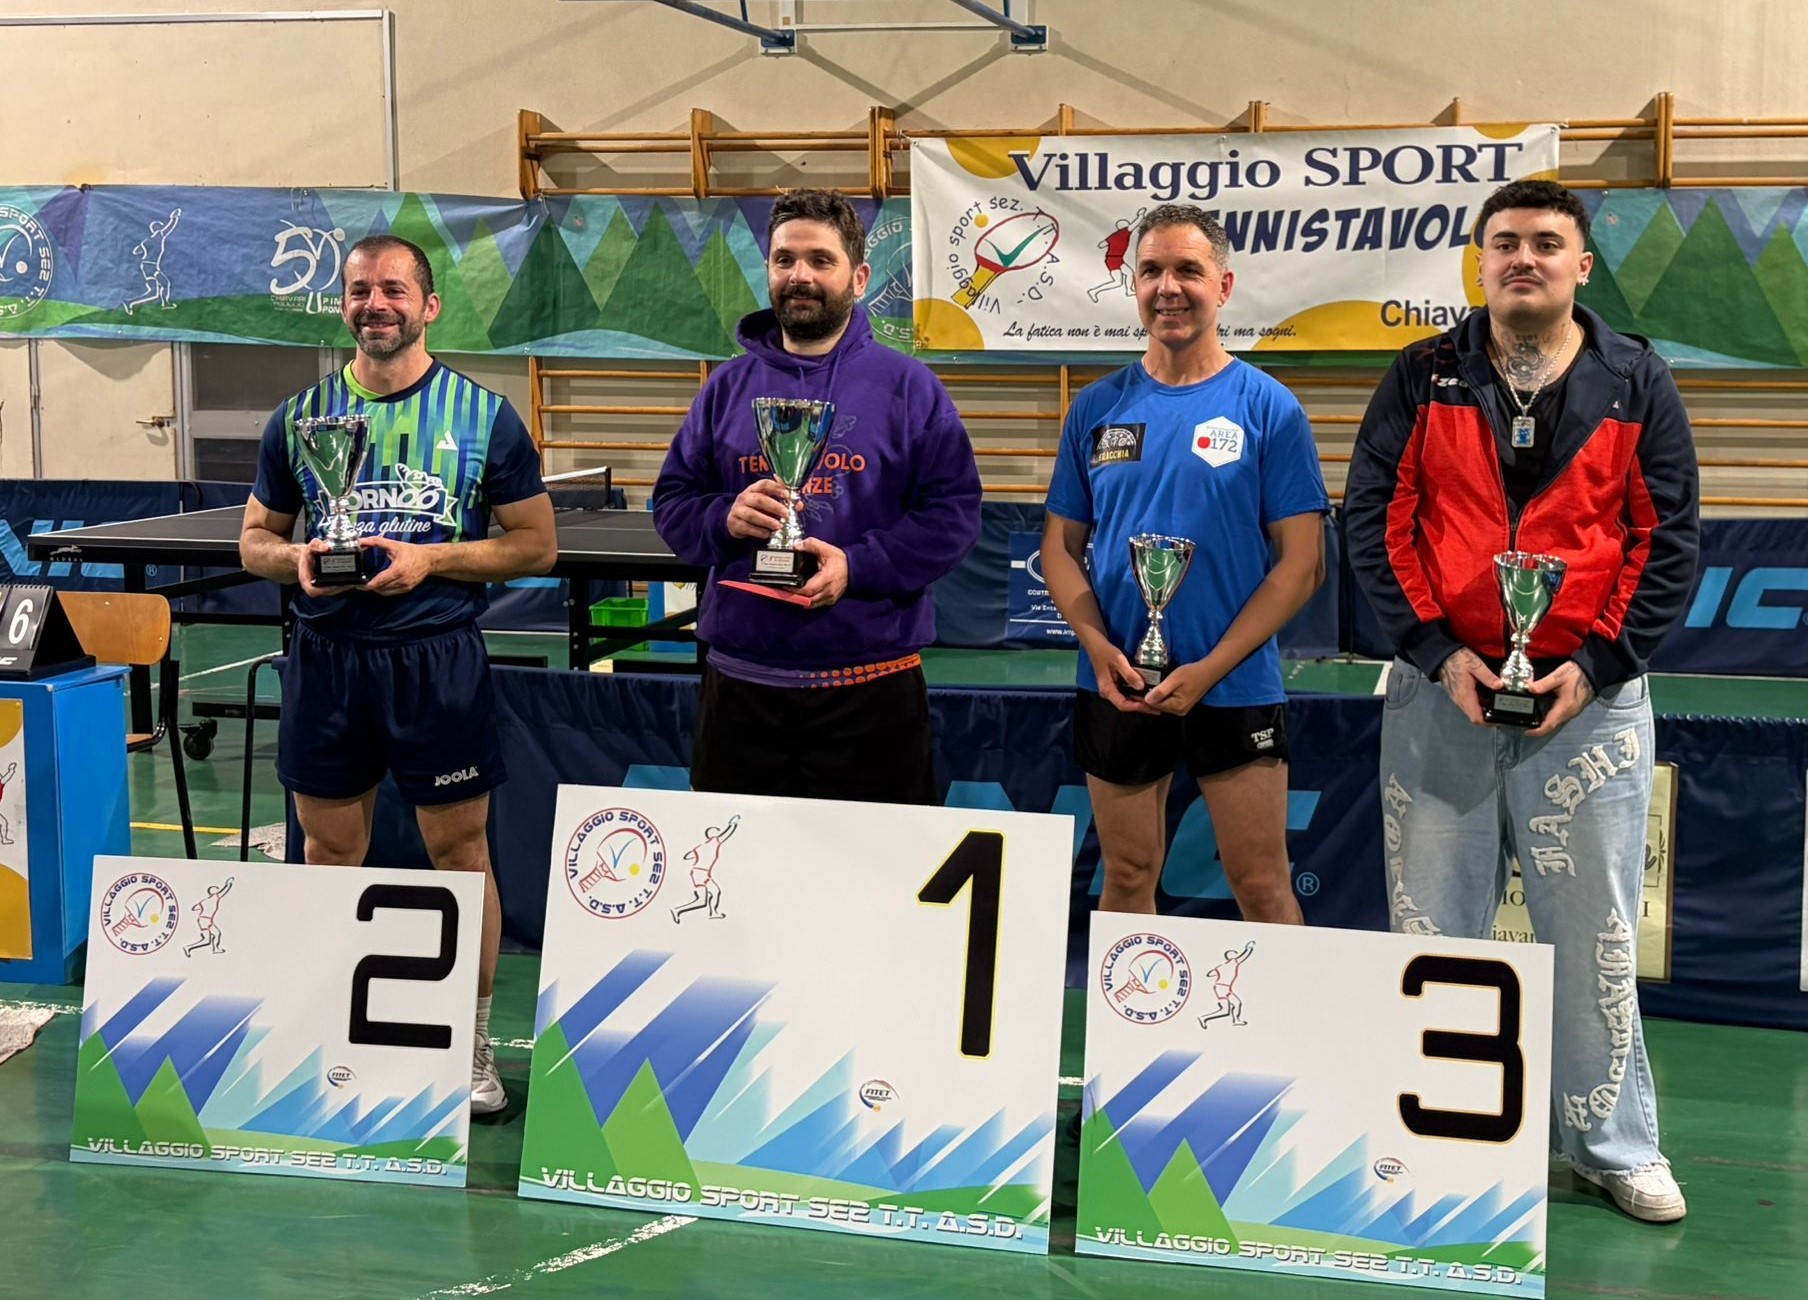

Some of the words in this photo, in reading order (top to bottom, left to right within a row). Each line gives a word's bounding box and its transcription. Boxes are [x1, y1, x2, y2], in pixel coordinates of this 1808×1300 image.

[1008, 150, 1281, 201] Villaggio
[1304, 142, 1523, 187] SPORT
[949, 201, 982, 246] sport
[989, 196, 1024, 212] sez.
[1207, 204, 1484, 254] NNISTAVOL
[1003, 321, 1023, 337] La
[1026, 321, 1063, 340] fatica
[1067, 328, 1089, 337] non
[1105, 325, 1130, 337] mai
[1234, 328, 1254, 337] ma
[1258, 325, 1297, 340] sogni.
[1209, 429, 1238, 439] AREA
[1212, 438, 1237, 453] 172
[379, 516, 431, 537] glutine
[8, 598, 34, 645] 6
[435, 766, 479, 787] JOOLA
[568, 811, 614, 879] VILLAGGIO
[619, 811, 660, 845] SPORT
[103, 876, 138, 926] VILLAGGIO
[141, 875, 174, 901] SPORT
[349, 884, 459, 1049] 2
[918, 830, 1004, 1057] 1
[1103, 936, 1142, 992] VILLAGGIO
[1146, 936, 1185, 965] SPORT
[1399, 954, 1524, 1142] 3
[87, 1137, 204, 1158] VILLAGGIO
[210, 1145, 285, 1165] SPORT
[384, 1157, 448, 1176] A.S.D.
[540, 1167, 693, 1202] VILLAGGIO
[699, 1185, 801, 1215] SPORT
[935, 1211, 1024, 1240] A.S.D.
[1095, 1226, 1231, 1254] VILLAGGIO
[1237, 1241, 1327, 1265] SPORT
[1446, 1262, 1523, 1286] A.S.D.
